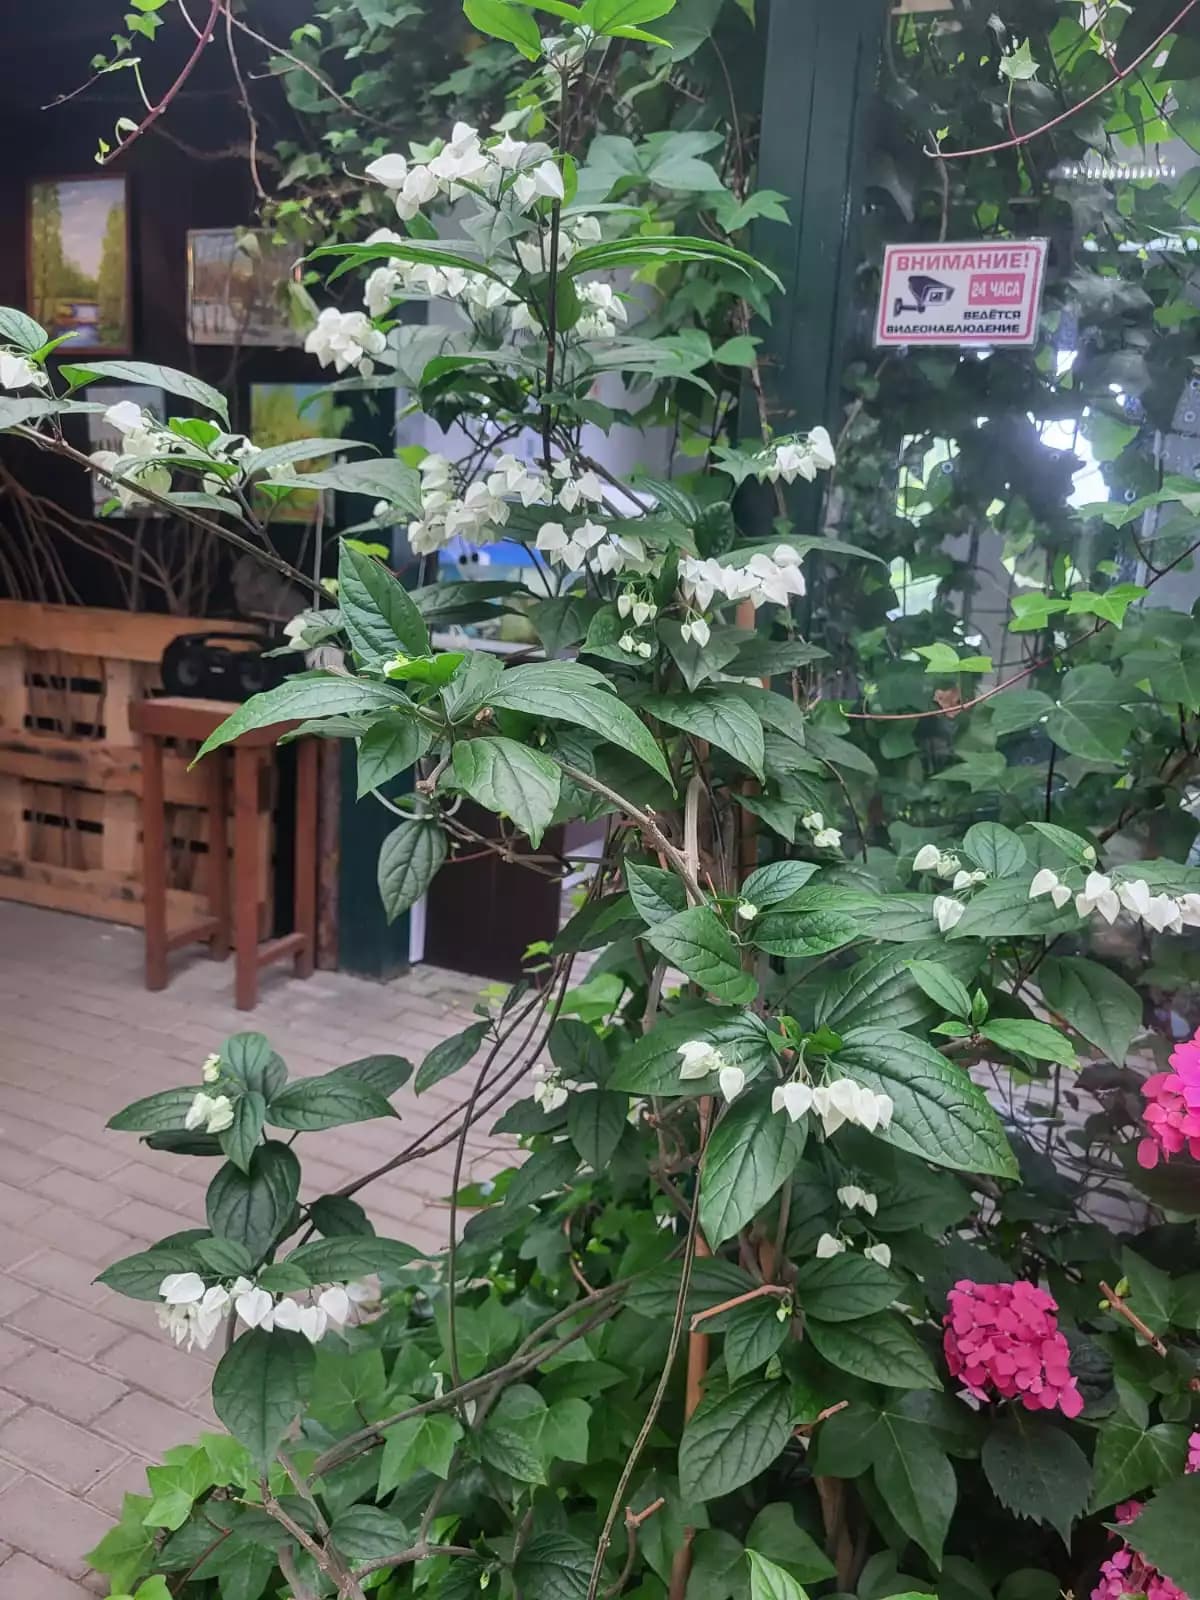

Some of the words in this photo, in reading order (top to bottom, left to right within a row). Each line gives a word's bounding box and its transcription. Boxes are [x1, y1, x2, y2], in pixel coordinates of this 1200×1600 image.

[897, 253, 1029, 271] ВНИМАНИЕ!
[972, 281, 986, 297] 24
[990, 280, 1020, 297] ЧАСА
[963, 310, 1021, 320] ВЕДЁТСЯ
[886, 324, 1020, 334] ВИДЕОНАБЛЮДЕНИЕ
